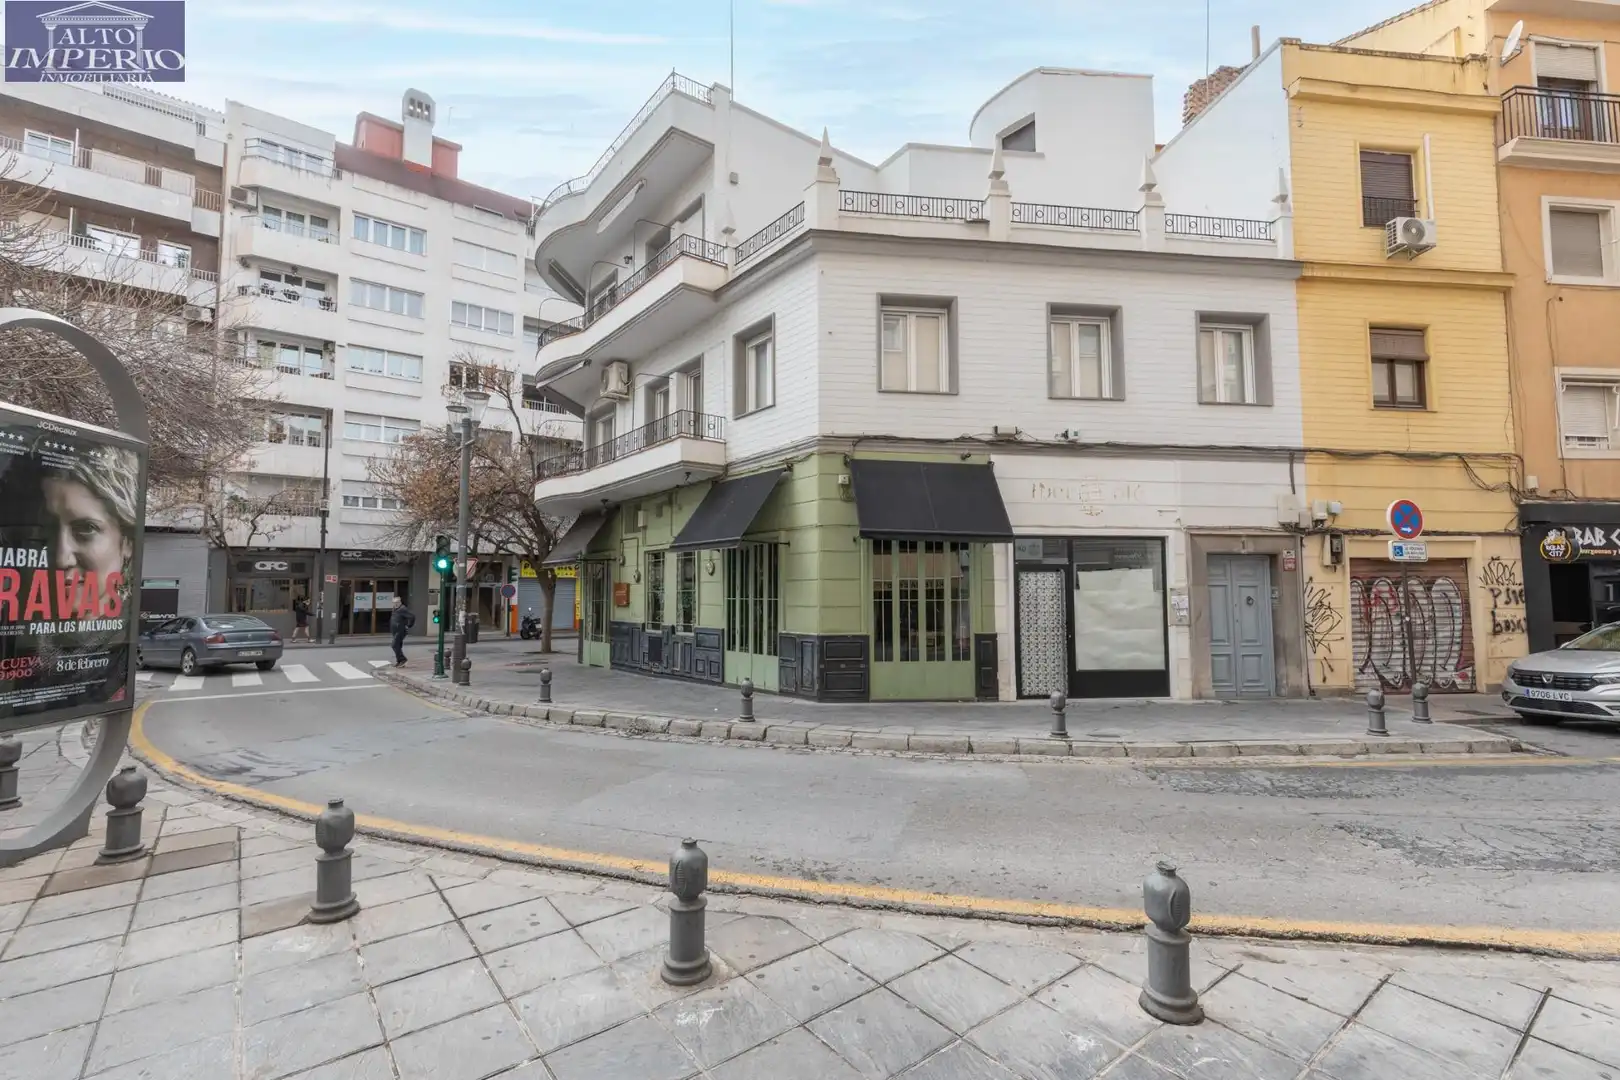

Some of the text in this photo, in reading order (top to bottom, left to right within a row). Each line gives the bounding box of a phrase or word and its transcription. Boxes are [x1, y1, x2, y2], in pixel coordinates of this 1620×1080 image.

[37, 421, 78, 436] JCDecaux
[29, 622, 56, 635] PARA
[58, 621, 76, 633] LOS
[78, 619, 123, 632] MALVADOS
[1, 657, 42, 670] CUEVA
[56, 657, 109, 672] 8 de febrero
[1530, 690, 1570, 701] 9706 LVC
